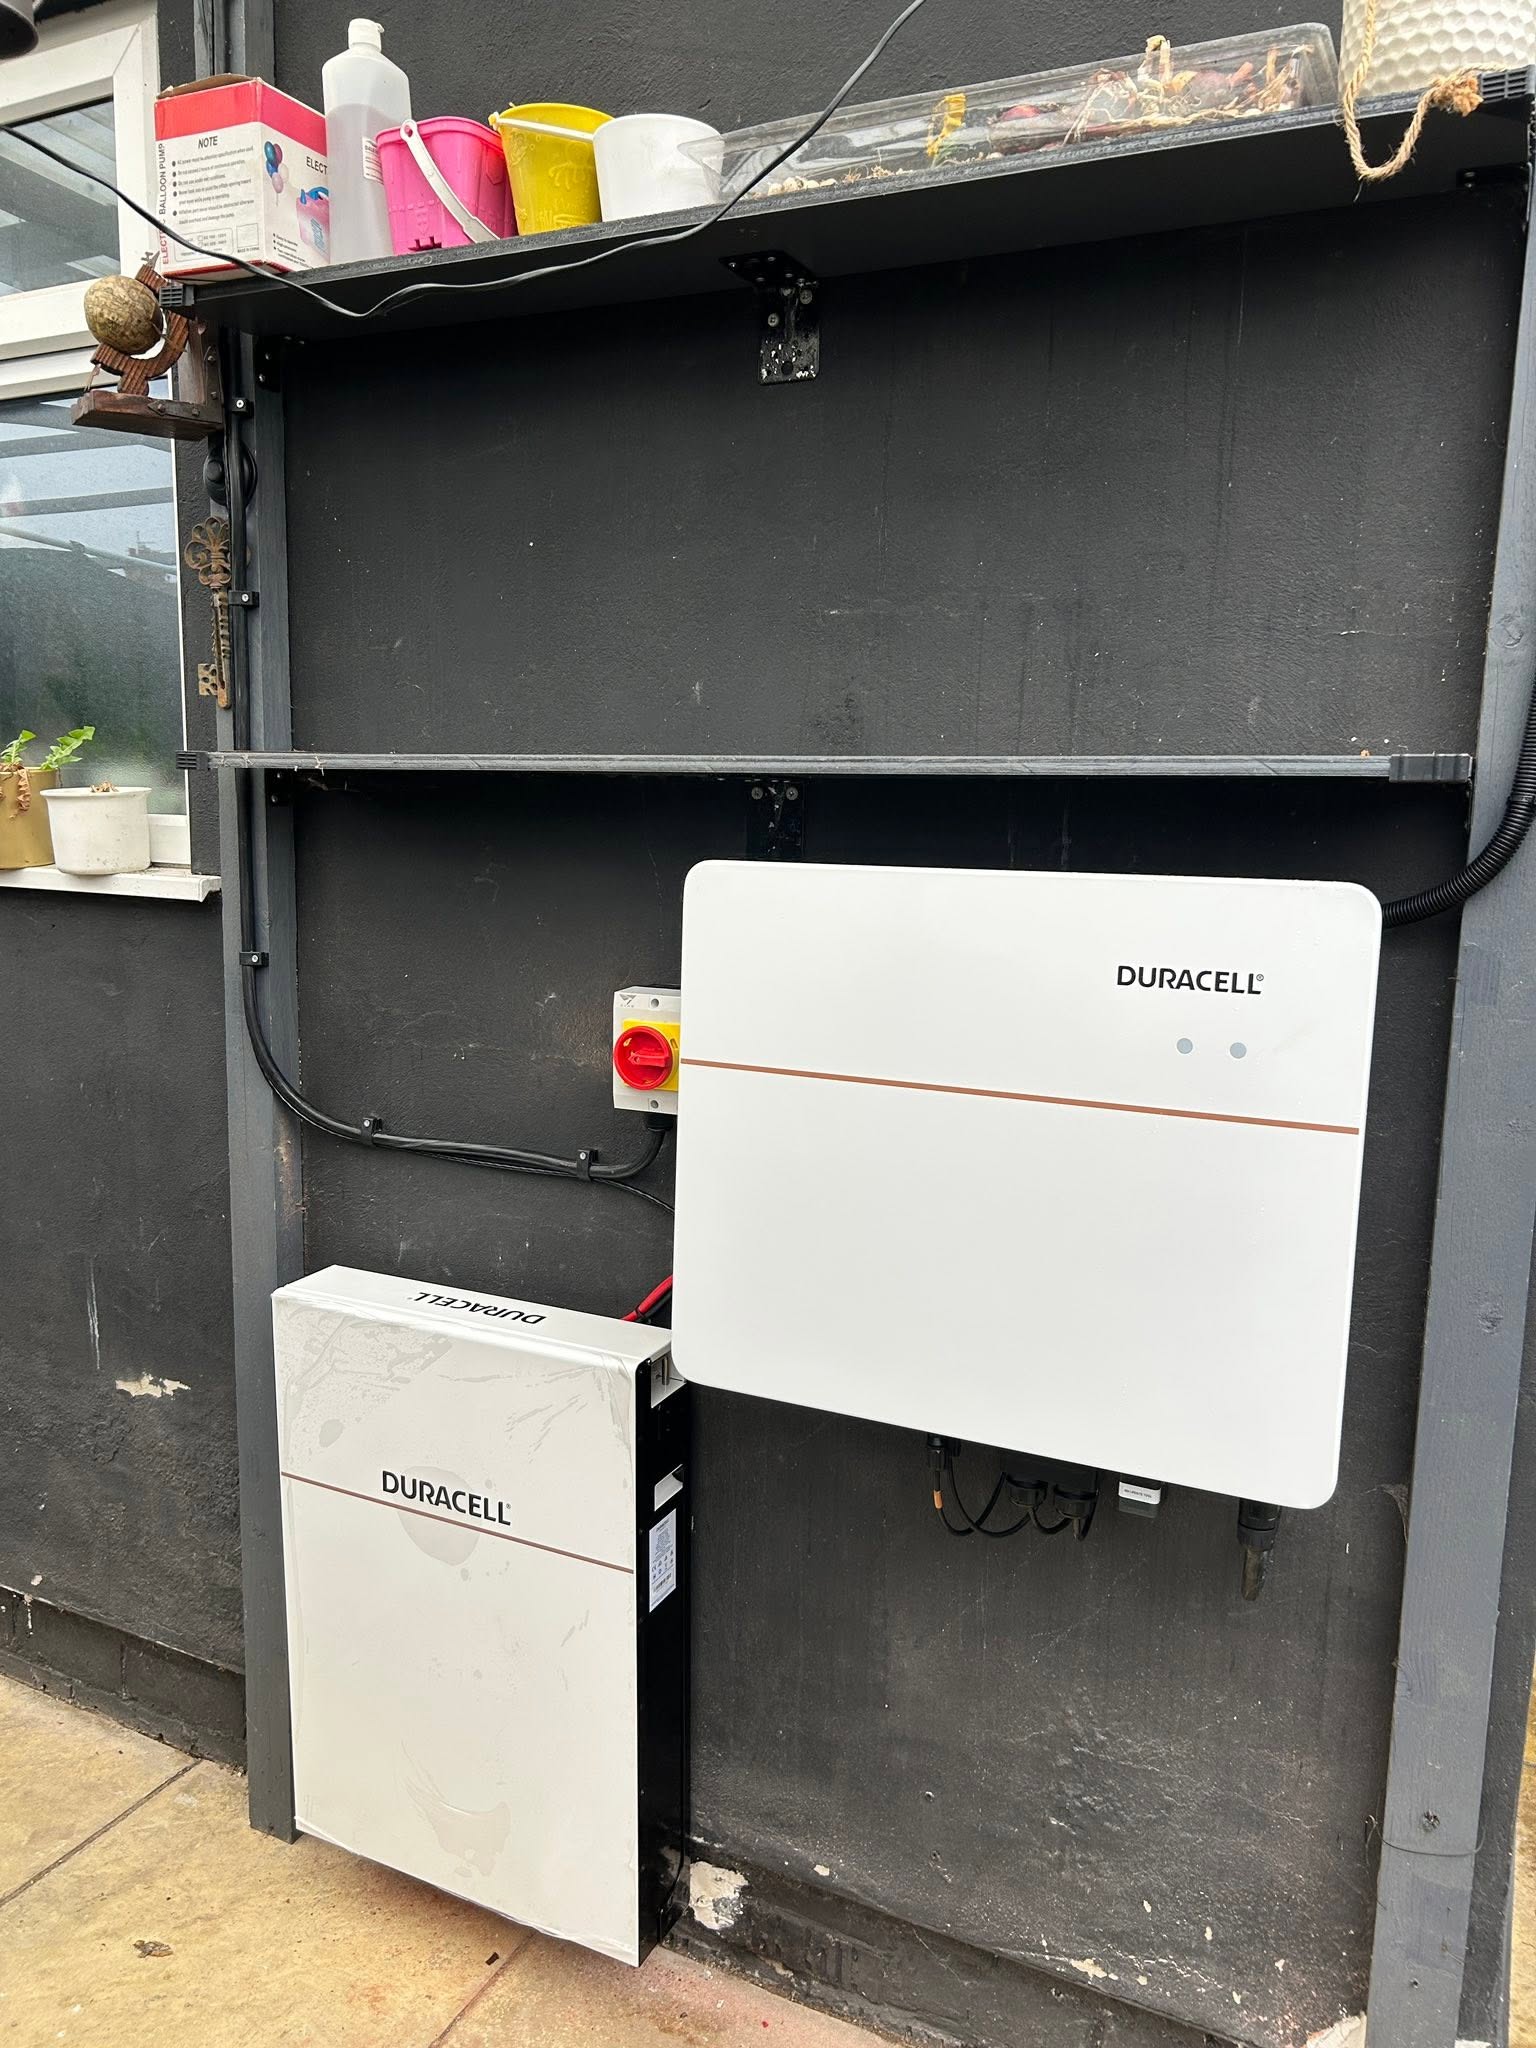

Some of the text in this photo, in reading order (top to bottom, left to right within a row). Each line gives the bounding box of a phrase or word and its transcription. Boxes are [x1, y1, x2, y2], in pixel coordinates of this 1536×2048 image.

[158, 143, 166, 170] PUMP
[198, 135, 218, 149] NOTE
[158, 171, 167, 215] BALLOON
[413, 1292, 547, 1325] DURACELL
